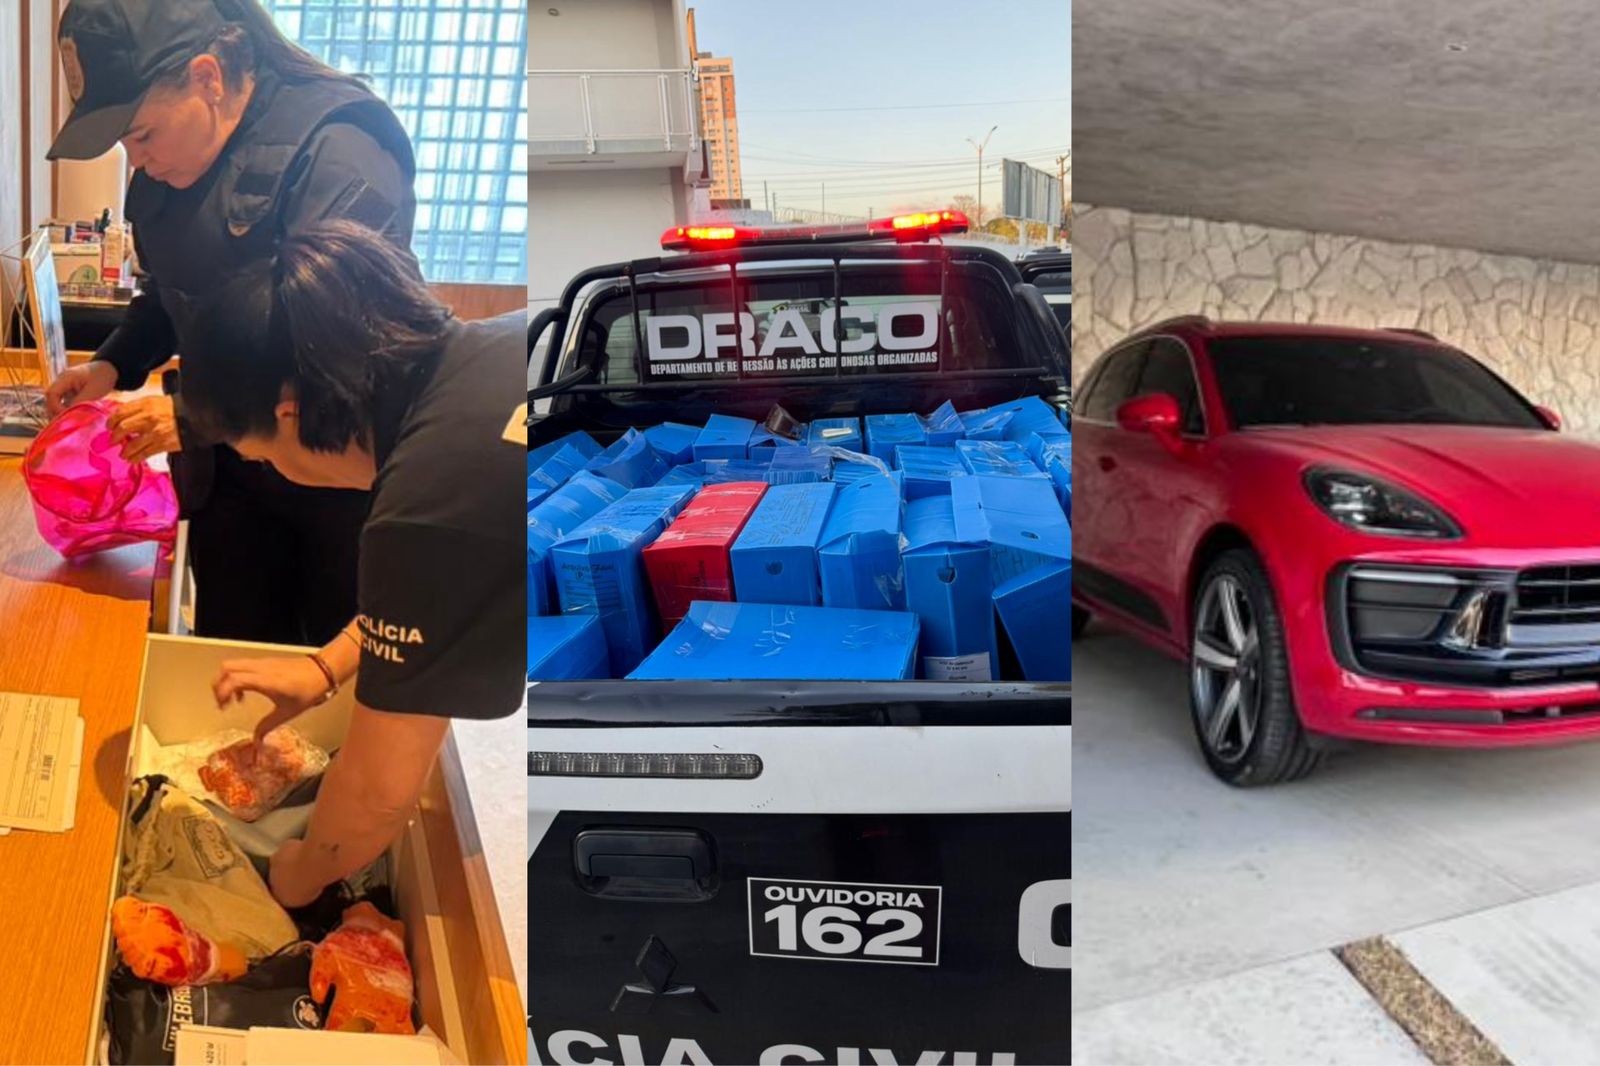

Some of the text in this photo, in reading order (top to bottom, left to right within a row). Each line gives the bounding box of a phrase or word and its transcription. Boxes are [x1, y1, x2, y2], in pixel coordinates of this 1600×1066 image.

[647, 302, 938, 361] DRACO
[650, 362, 713, 375] DEPARTAMENTO
[714, 361, 726, 373] DE
[727, 357, 774, 373] RERESSÃO
[776, 357, 788, 371] ÀS
[790, 355, 817, 371] AÇÕES
[877, 351, 938, 366] ORGANIZADAS
[764, 885, 924, 908] OUVIDORIA
[764, 904, 924, 957] 162
